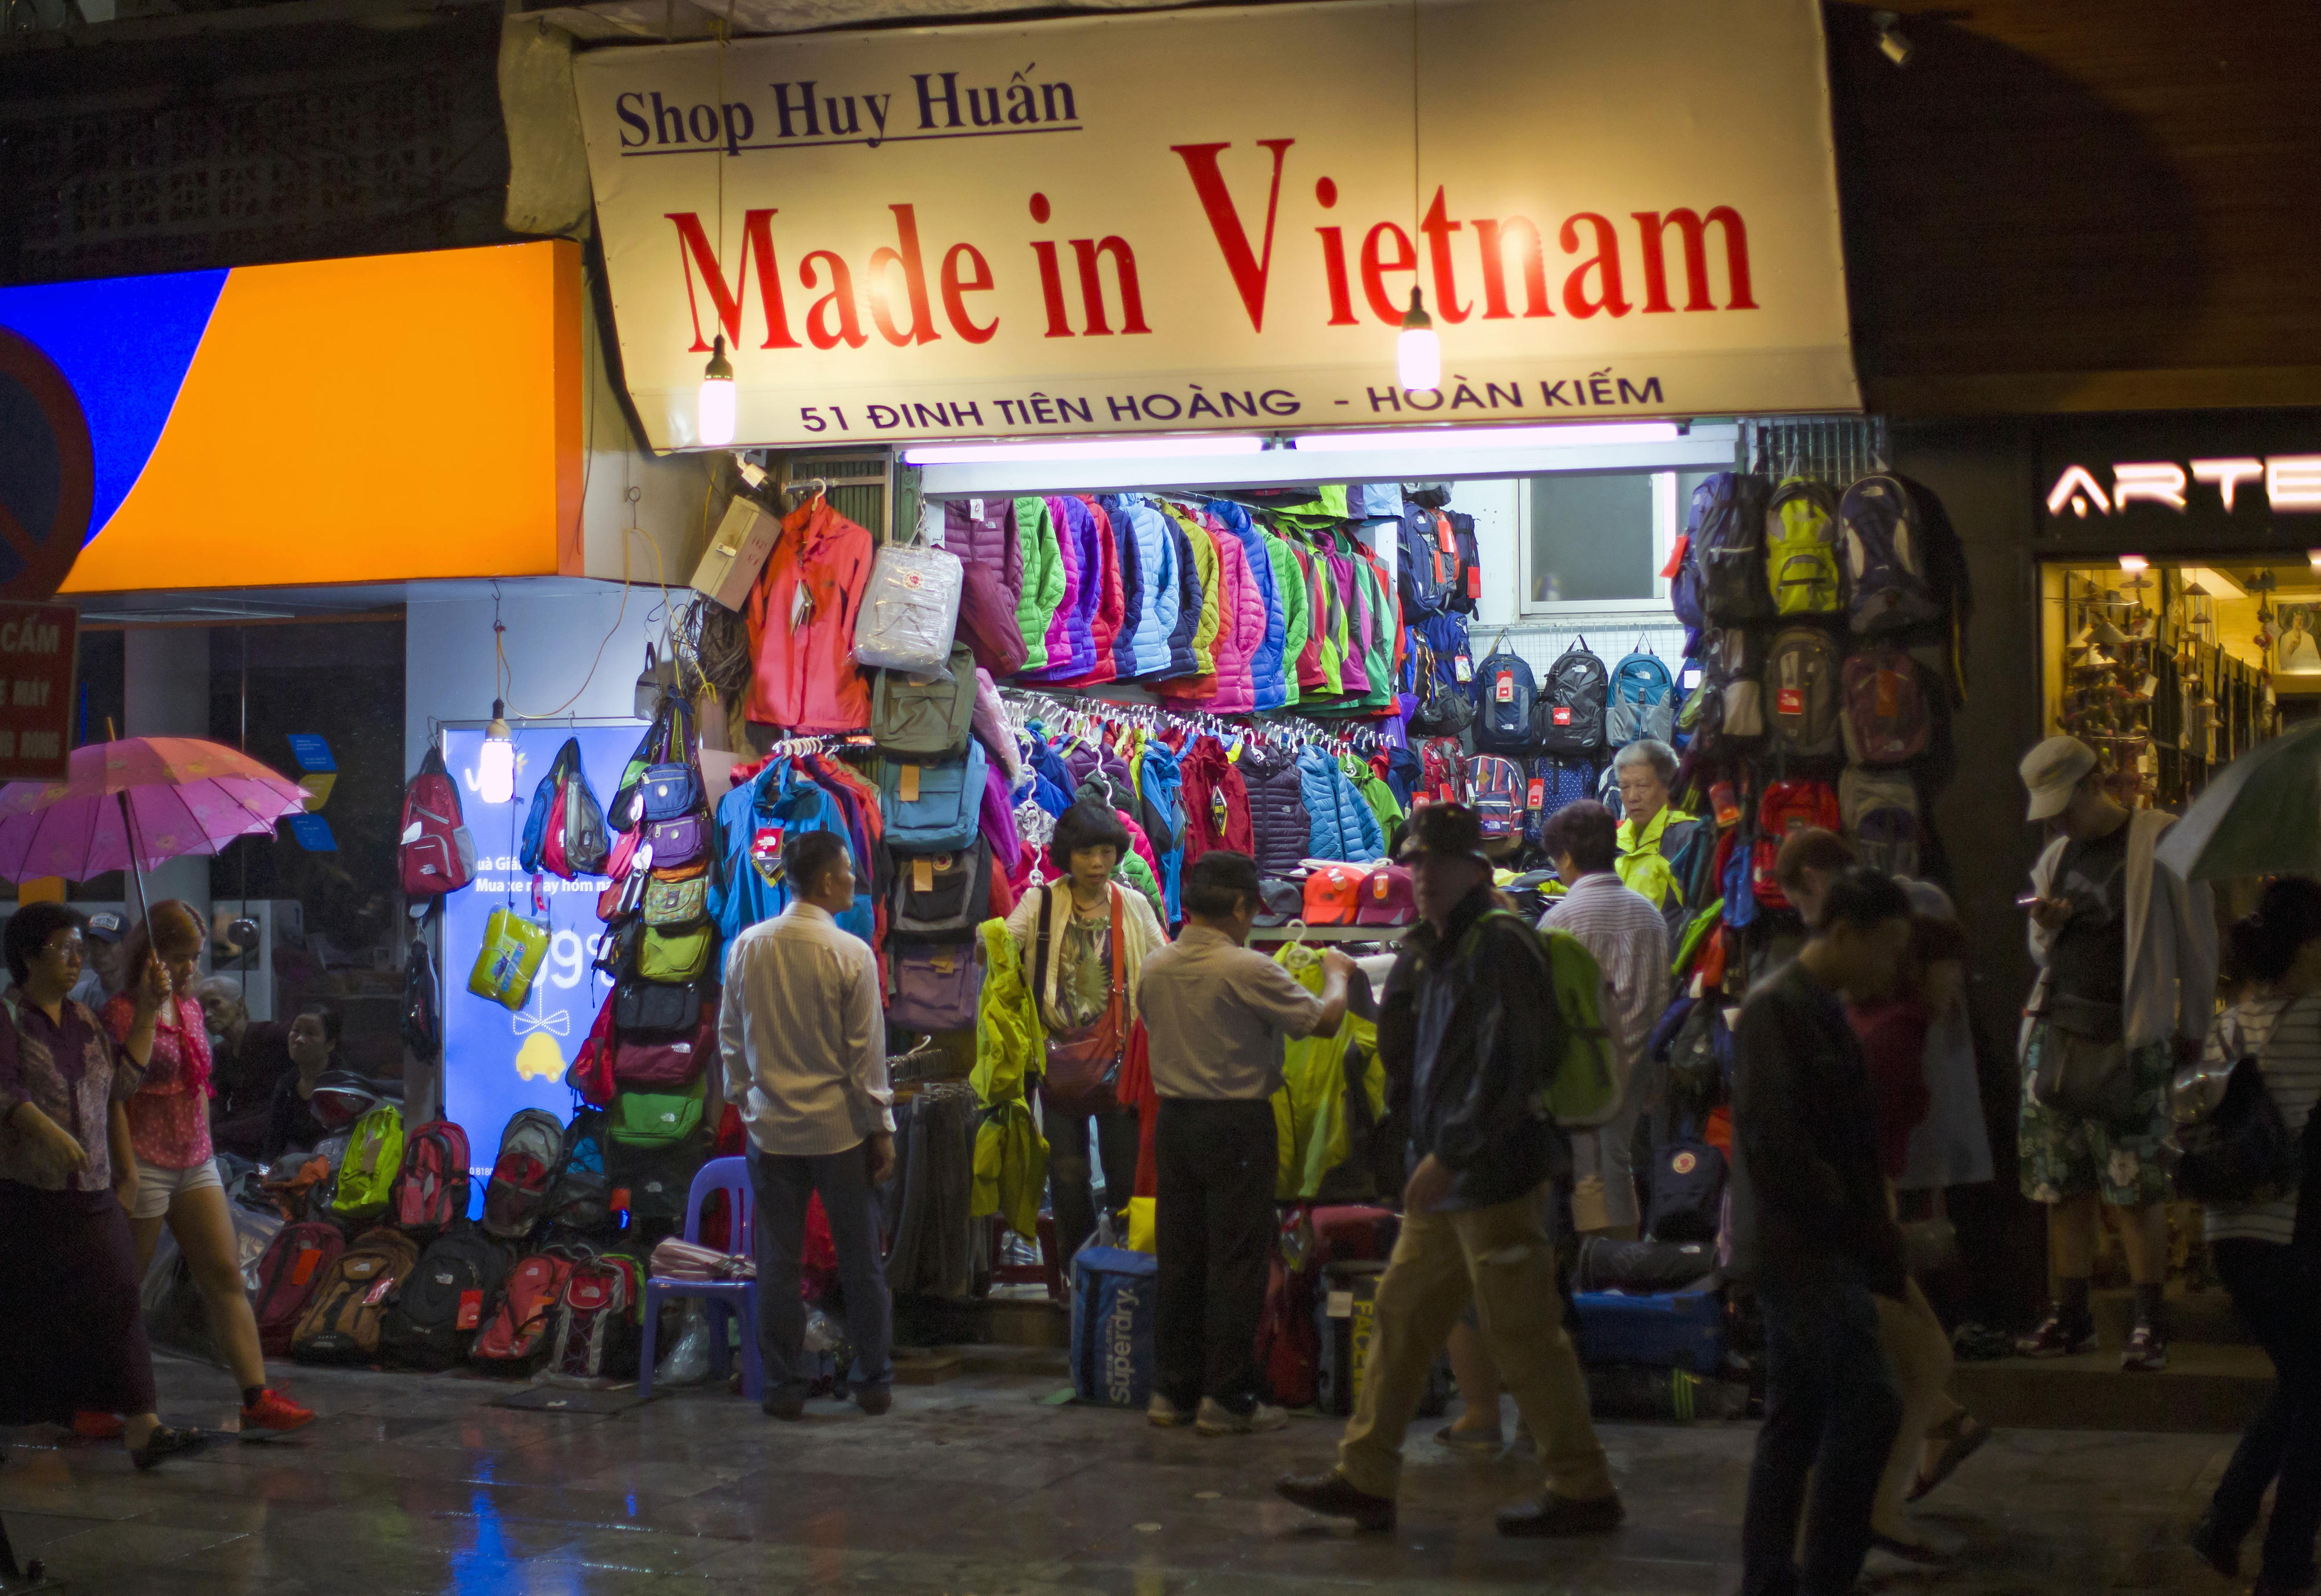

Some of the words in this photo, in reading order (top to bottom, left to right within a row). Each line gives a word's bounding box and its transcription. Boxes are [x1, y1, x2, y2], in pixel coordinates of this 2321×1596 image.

[616, 91, 754, 156] Shop
[770, 81, 890, 148] Huy
[910, 62, 1078, 129] Huấn
[664, 203, 1000, 352] Made
[1029, 191, 1152, 338] in
[1170, 138, 1760, 333] Vietnam
[801, 406, 849, 432] 51
[867, 401, 984, 429] ĐINH
[993, 392, 1094, 425] TIÊN
[1106, 383, 1300, 422] HOÀNG
[1366, 375, 1523, 412] HOÀN
[1541, 367, 1664, 406] KIẾM
[1, 613, 60, 654] CẤM
[476, 878, 505, 892] Mua
[507, 881, 523, 892] xe
[478, 856, 493, 870] uà
[1109, 1289, 1140, 1406] Superdry.
